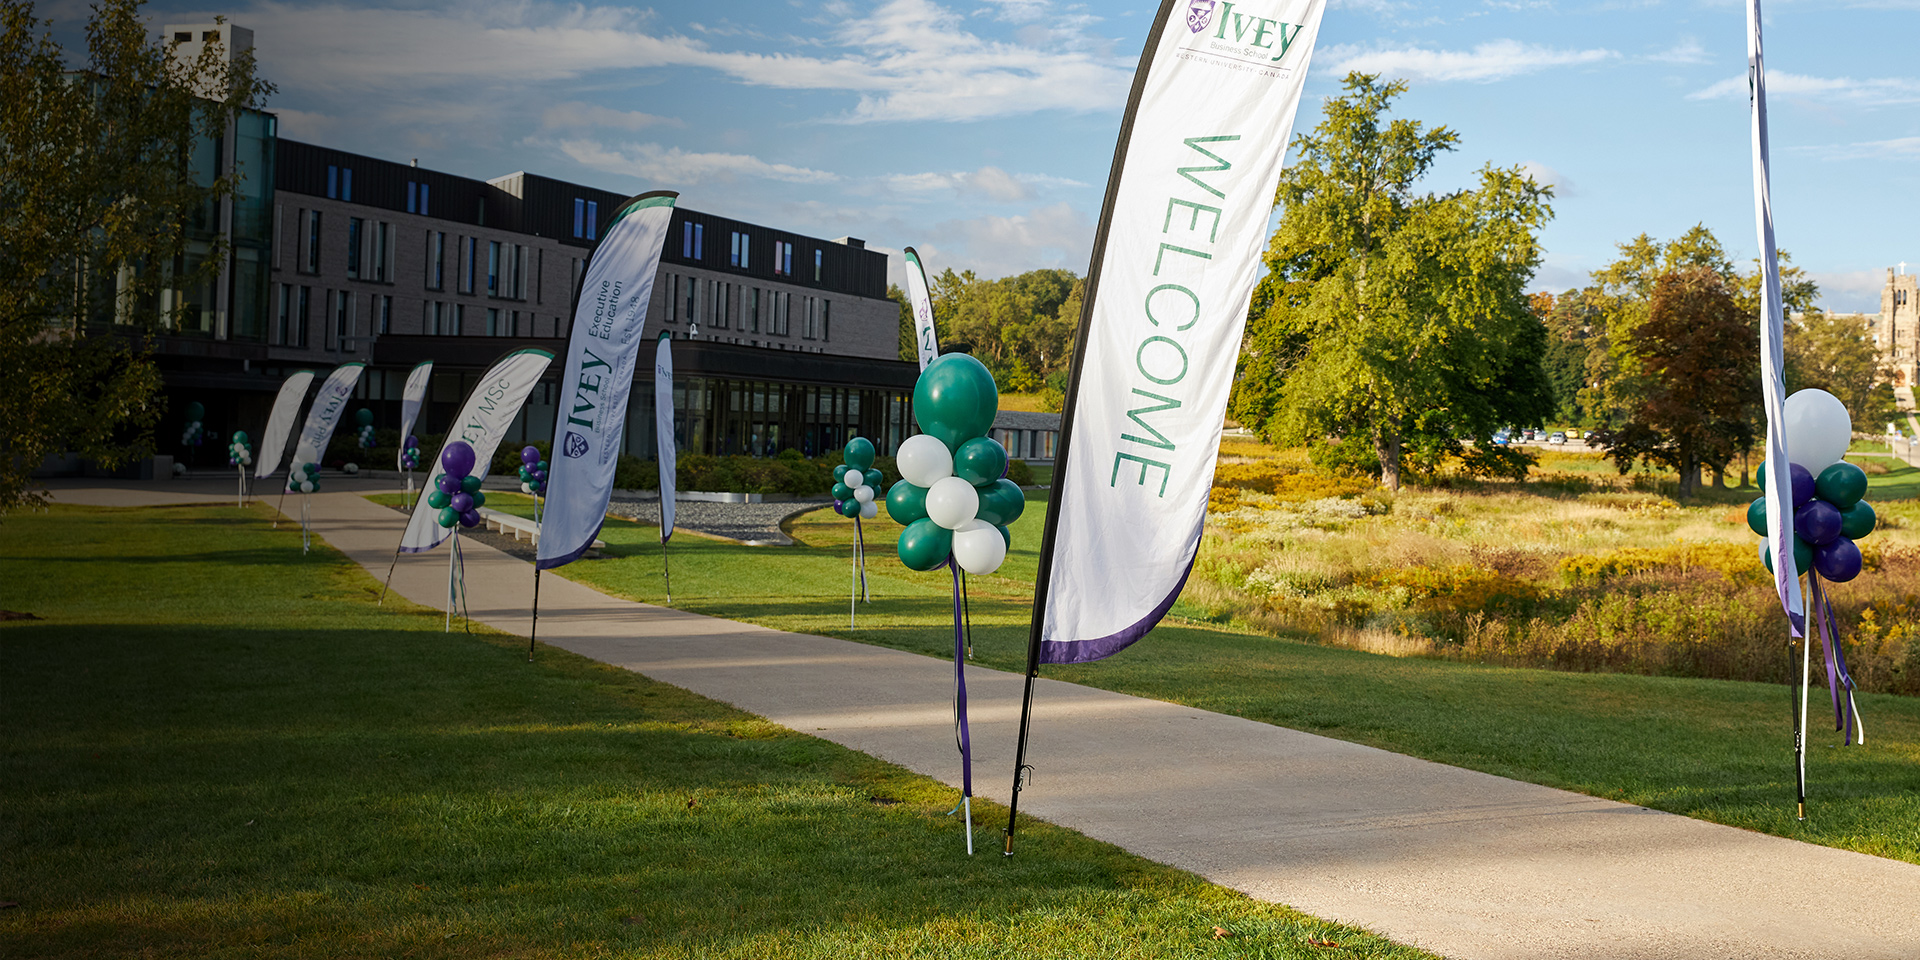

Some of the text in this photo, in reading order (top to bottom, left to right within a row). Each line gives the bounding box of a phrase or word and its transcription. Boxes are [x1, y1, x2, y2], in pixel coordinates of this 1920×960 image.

[1210, 41, 1269, 60] Business School
[1213, 1, 1304, 61] IVEY
[1210, 60, 1254, 73] UNIVERSITY
[1258, 69, 1290, 80] CANADA
[588, 280, 611, 337] Executive
[599, 280, 623, 340] Education
[620, 296, 640, 345] Est. 1948
[1110, 134, 1241, 498] WELCOME
[319, 395, 343, 425] IVEY
[478, 378, 510, 416] MSc
[567, 346, 612, 431] IVEY
[595, 377, 610, 433] Business School
